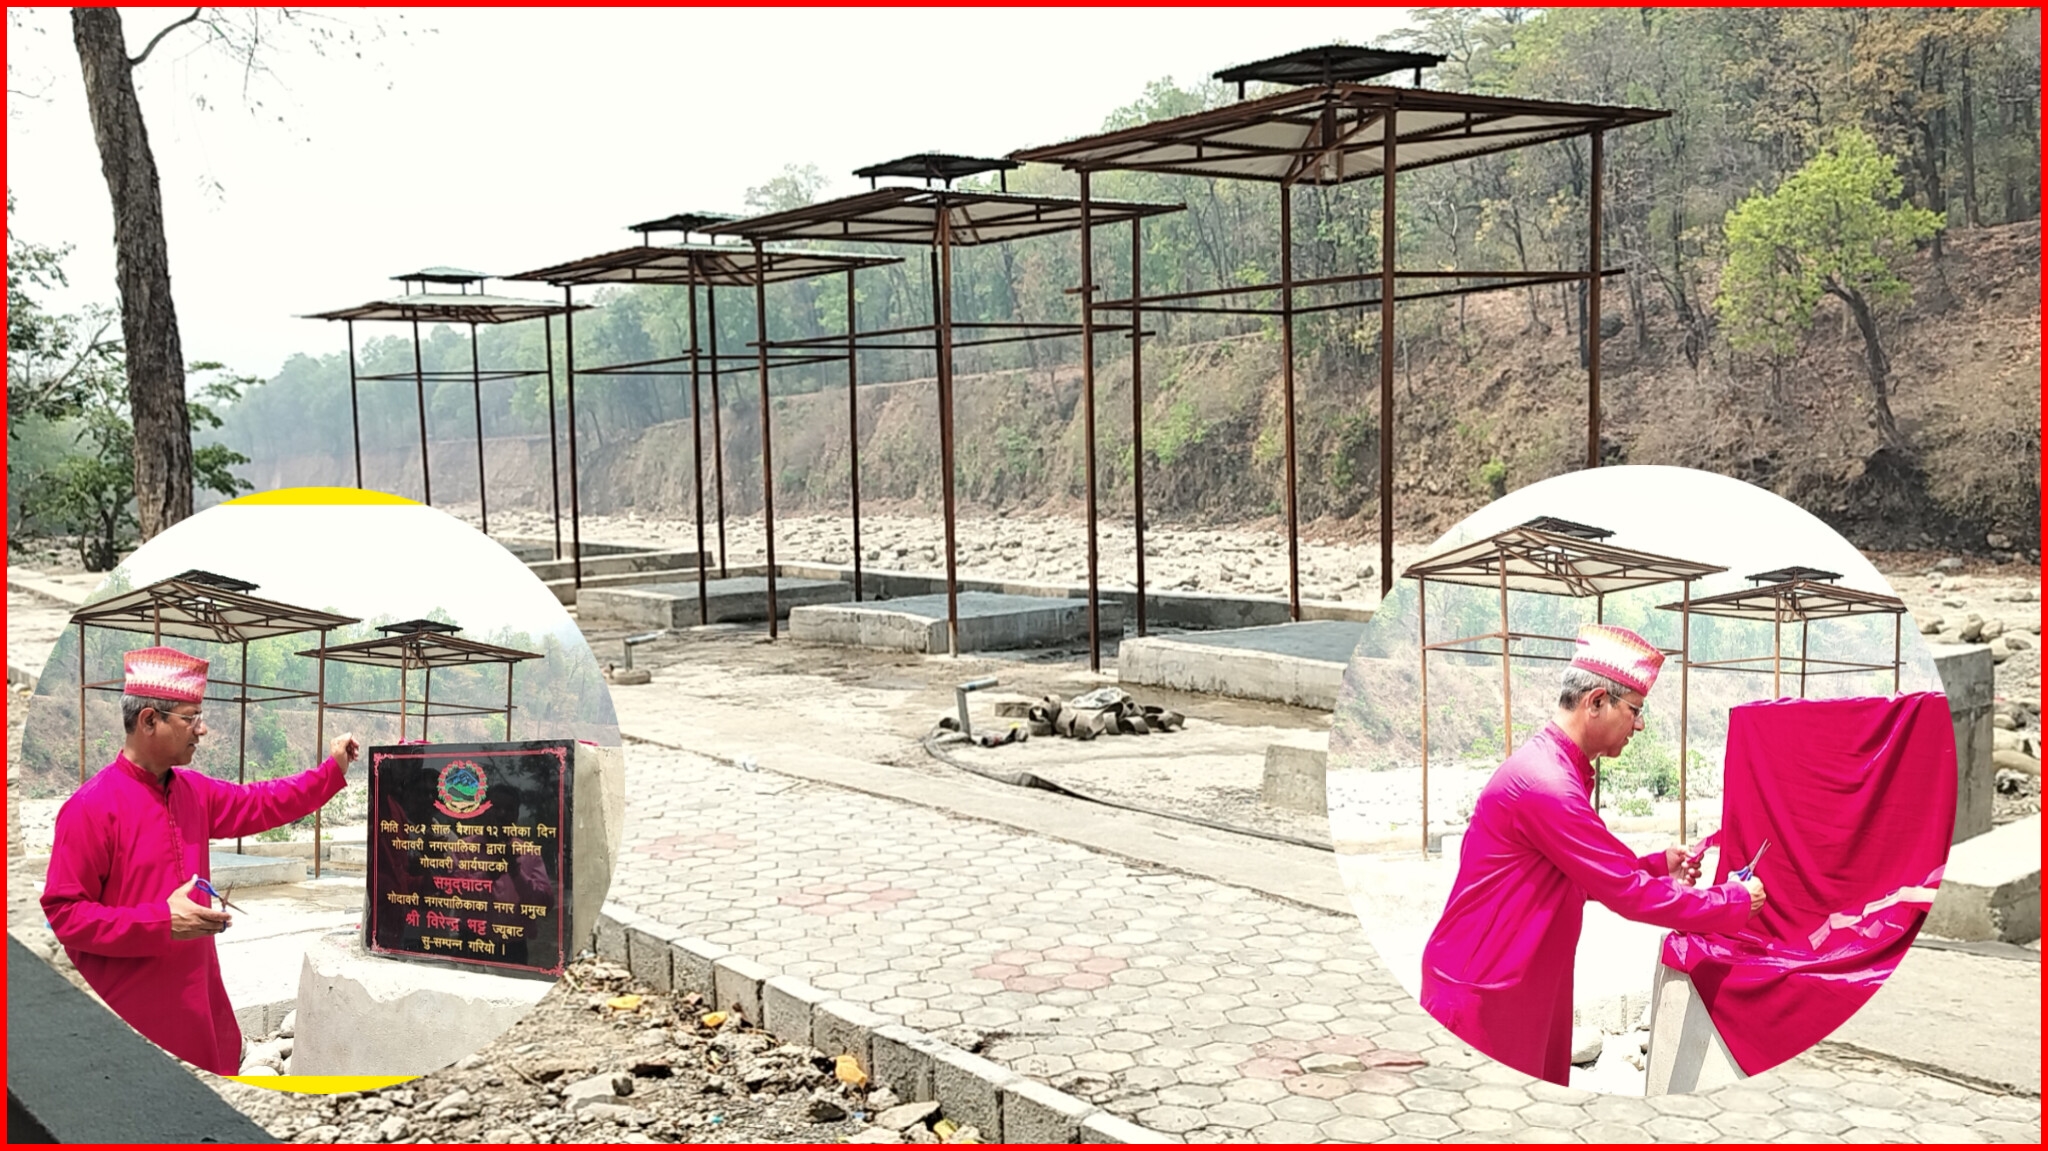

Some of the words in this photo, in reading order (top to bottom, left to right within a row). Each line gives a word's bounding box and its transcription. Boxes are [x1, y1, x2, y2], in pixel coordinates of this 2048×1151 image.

[380, 820, 399, 833] मिति
[431, 823, 450, 835] साल
[486, 824, 499, 837] १२
[502, 823, 531, 837] गतेका
[537, 824, 557, 839] दिन
[391, 836, 424, 851] गोदावरी
[429, 837, 481, 853] नगरपालिका
[486, 842, 506, 855] द्वारा
[511, 840, 542, 856] निर्मित
[419, 855, 453, 869] गोदावरी
[458, 857, 508, 872] आर्यघाटको
[386, 890, 419, 906] गोदावरी
[424, 894, 488, 912] नगरपालिकाका
[493, 902, 514, 914] नगर
[520, 903, 547, 919] प्रमुख
[405, 909, 420, 927] श्री
[426, 911, 460, 931] विरेन्द्र
[468, 938, 495, 954] गरियो
